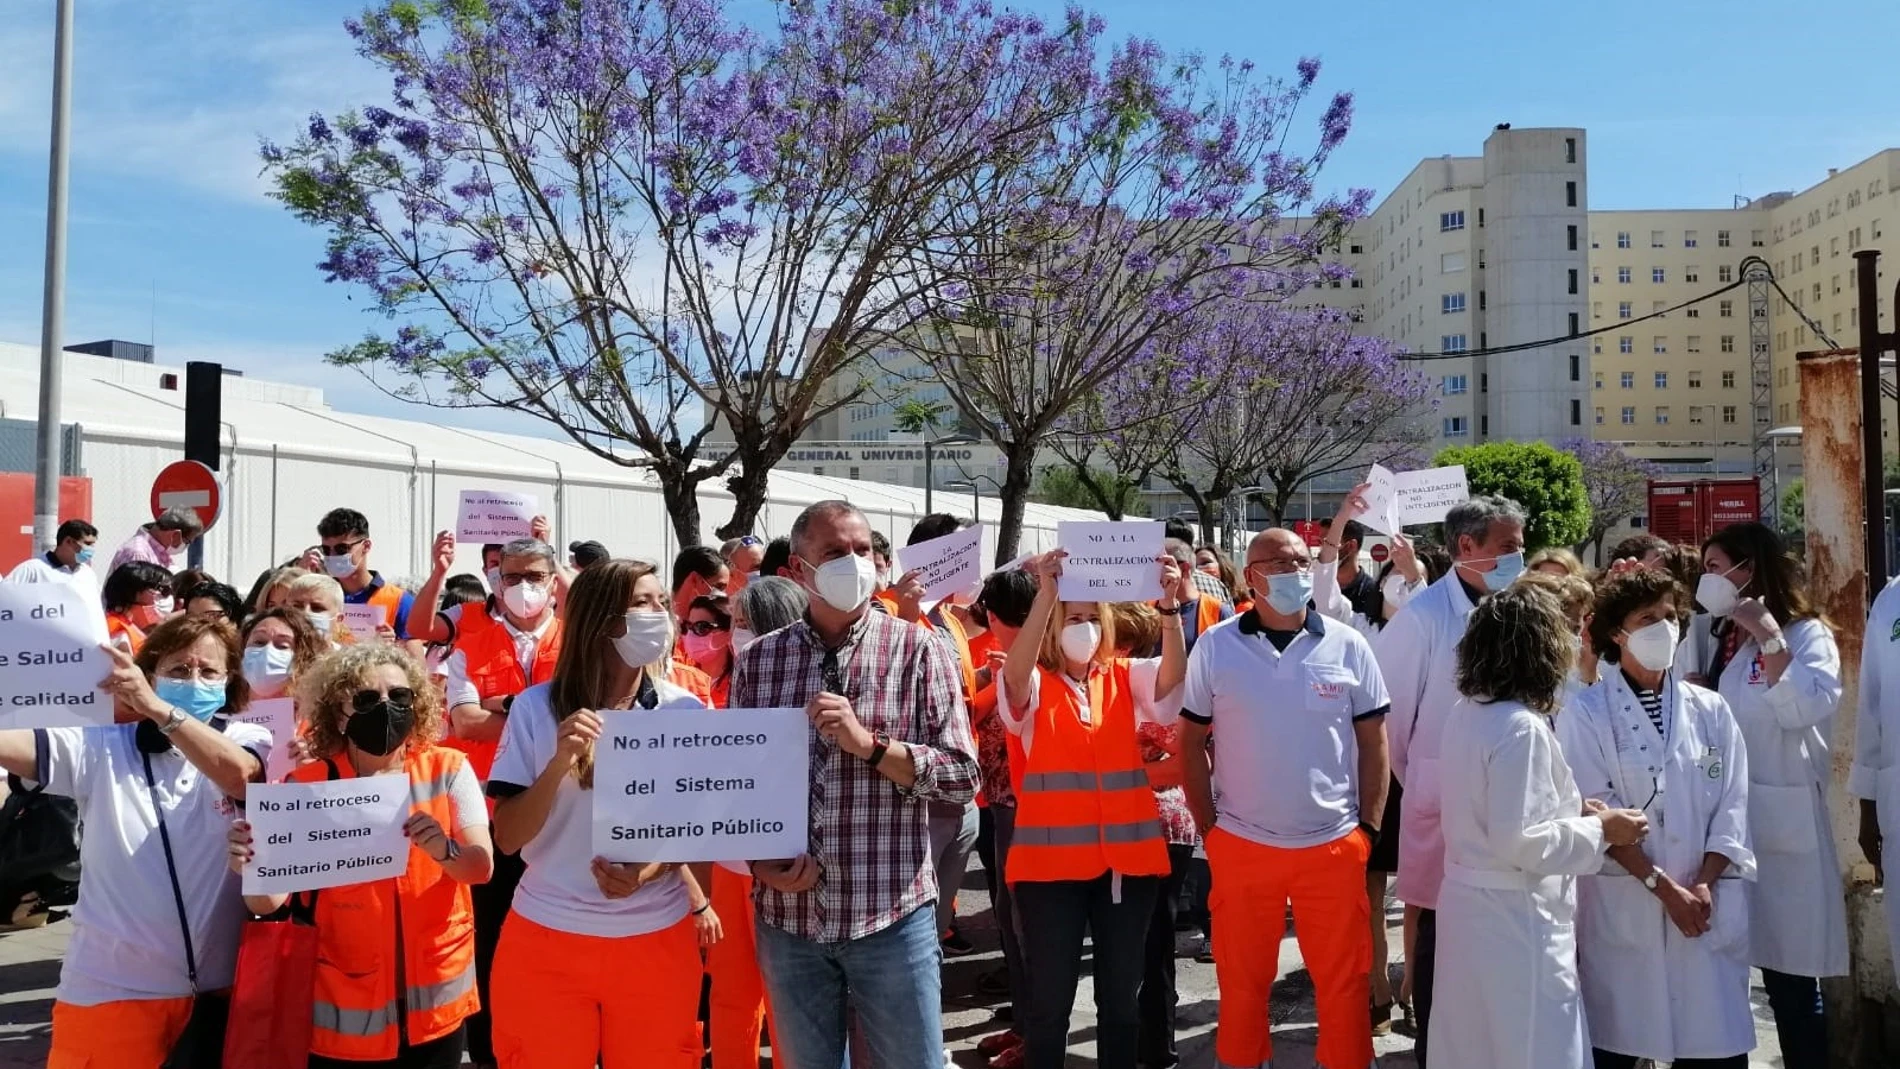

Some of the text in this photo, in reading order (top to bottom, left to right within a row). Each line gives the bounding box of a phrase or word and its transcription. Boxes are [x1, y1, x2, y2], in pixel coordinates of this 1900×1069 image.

[787, 450, 972, 461] GENERAL UNIVERSTARIO
[468, 512, 519, 521] del Sistema
[463, 529, 499, 537] Sanitario
[1089, 535, 1103, 543] NO
[1122, 534, 1135, 543] LA
[912, 541, 977, 572] NTRALIZACION
[1069, 554, 1154, 565] CENTRALIZACIÓN
[928, 568, 940, 578] NO
[1089, 579, 1108, 588] DEL
[31, 603, 65, 620] del
[18, 648, 84, 666] Salud
[12, 691, 95, 706] calidad
[613, 733, 768, 751] No al retroceso
[625, 776, 755, 795] del Sistema
[259, 793, 380, 812] No al retroceso
[267, 826, 372, 845] del Sistema
[611, 818, 784, 840] Sanitario Público
[257, 855, 393, 878] Sanitario Público
